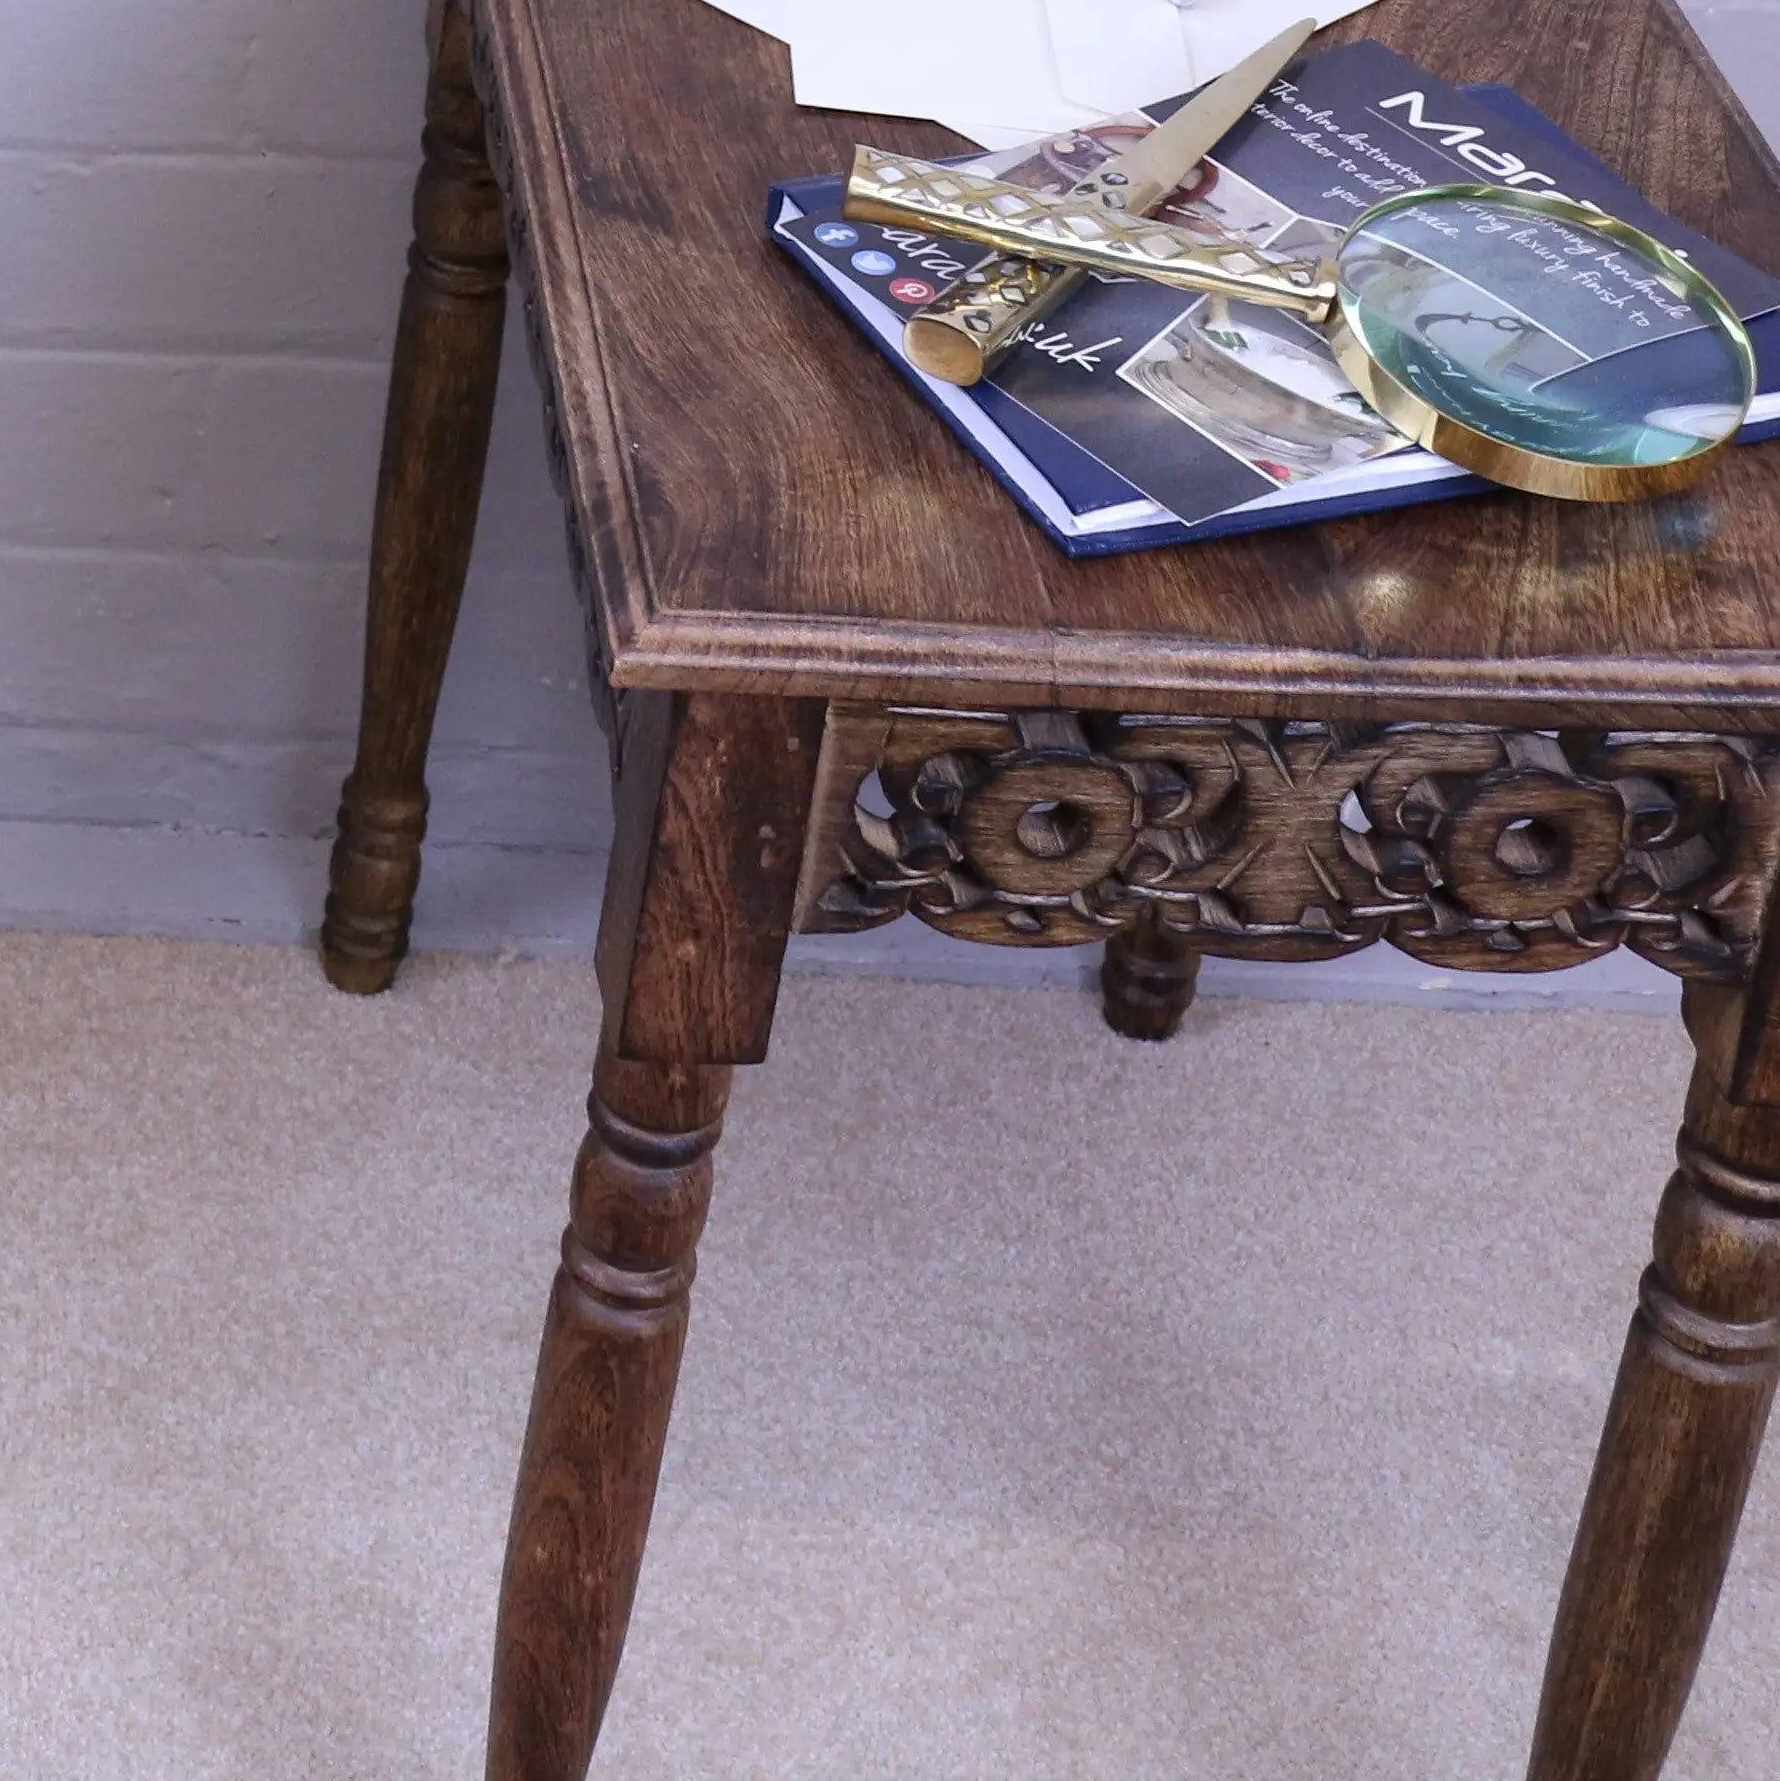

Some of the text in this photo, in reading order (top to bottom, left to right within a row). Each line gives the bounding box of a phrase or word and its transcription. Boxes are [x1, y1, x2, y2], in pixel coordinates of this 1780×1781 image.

[1250, 103, 1296, 132] terior
[1290, 132, 1338, 158] decor
[1337, 156, 1358, 172] to
[1353, 172, 1405, 193] add
[1506, 227, 1570, 273] luxury
[1572, 270, 1635, 309] finish
[1628, 309, 1651, 327] to
[1269, 79, 1300, 104] The
[1293, 103, 1341, 133] online
[1338, 133, 1427, 188] destination
[1595, 251, 1691, 320] handmade
[1322, 186, 1370, 208] your
